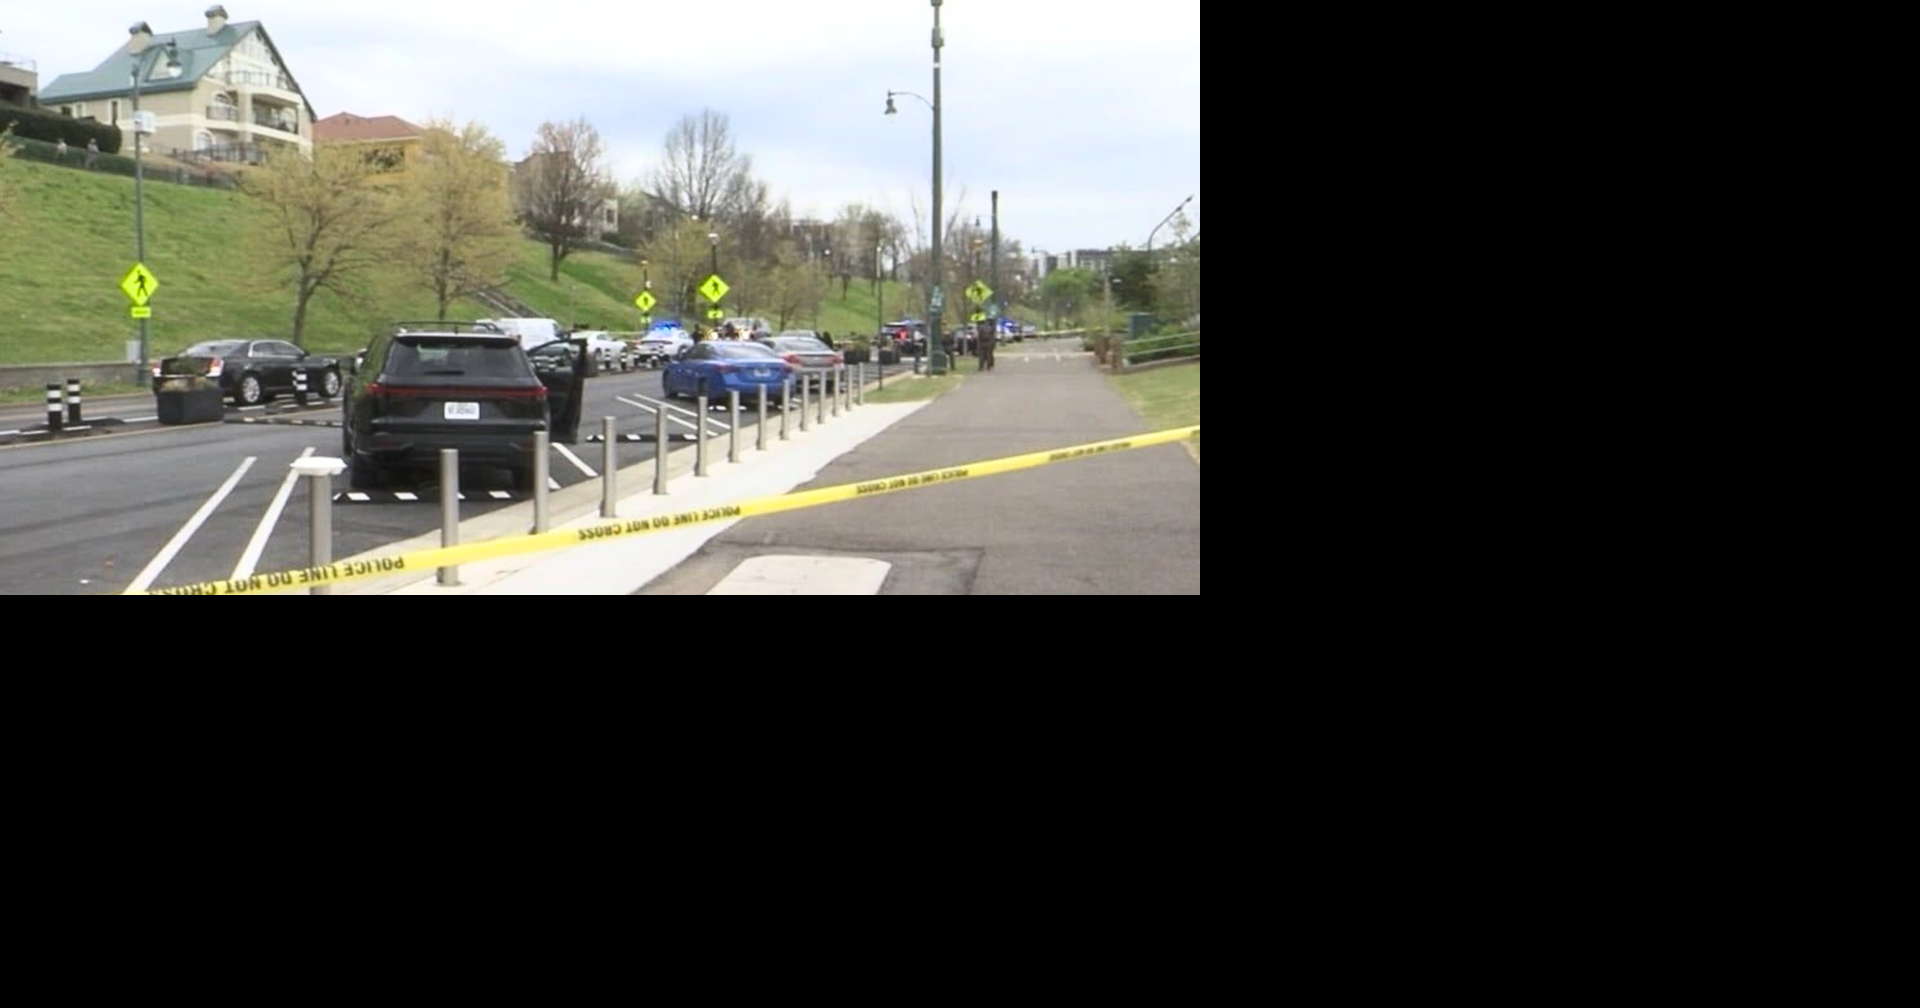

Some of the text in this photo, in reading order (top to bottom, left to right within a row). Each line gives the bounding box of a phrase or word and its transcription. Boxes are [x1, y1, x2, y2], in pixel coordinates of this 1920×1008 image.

[578, 505, 742, 541] POLICE LINE DO NOT CROSS
[149, 556, 405, 595] POLICE LINE DO NOT CRO
